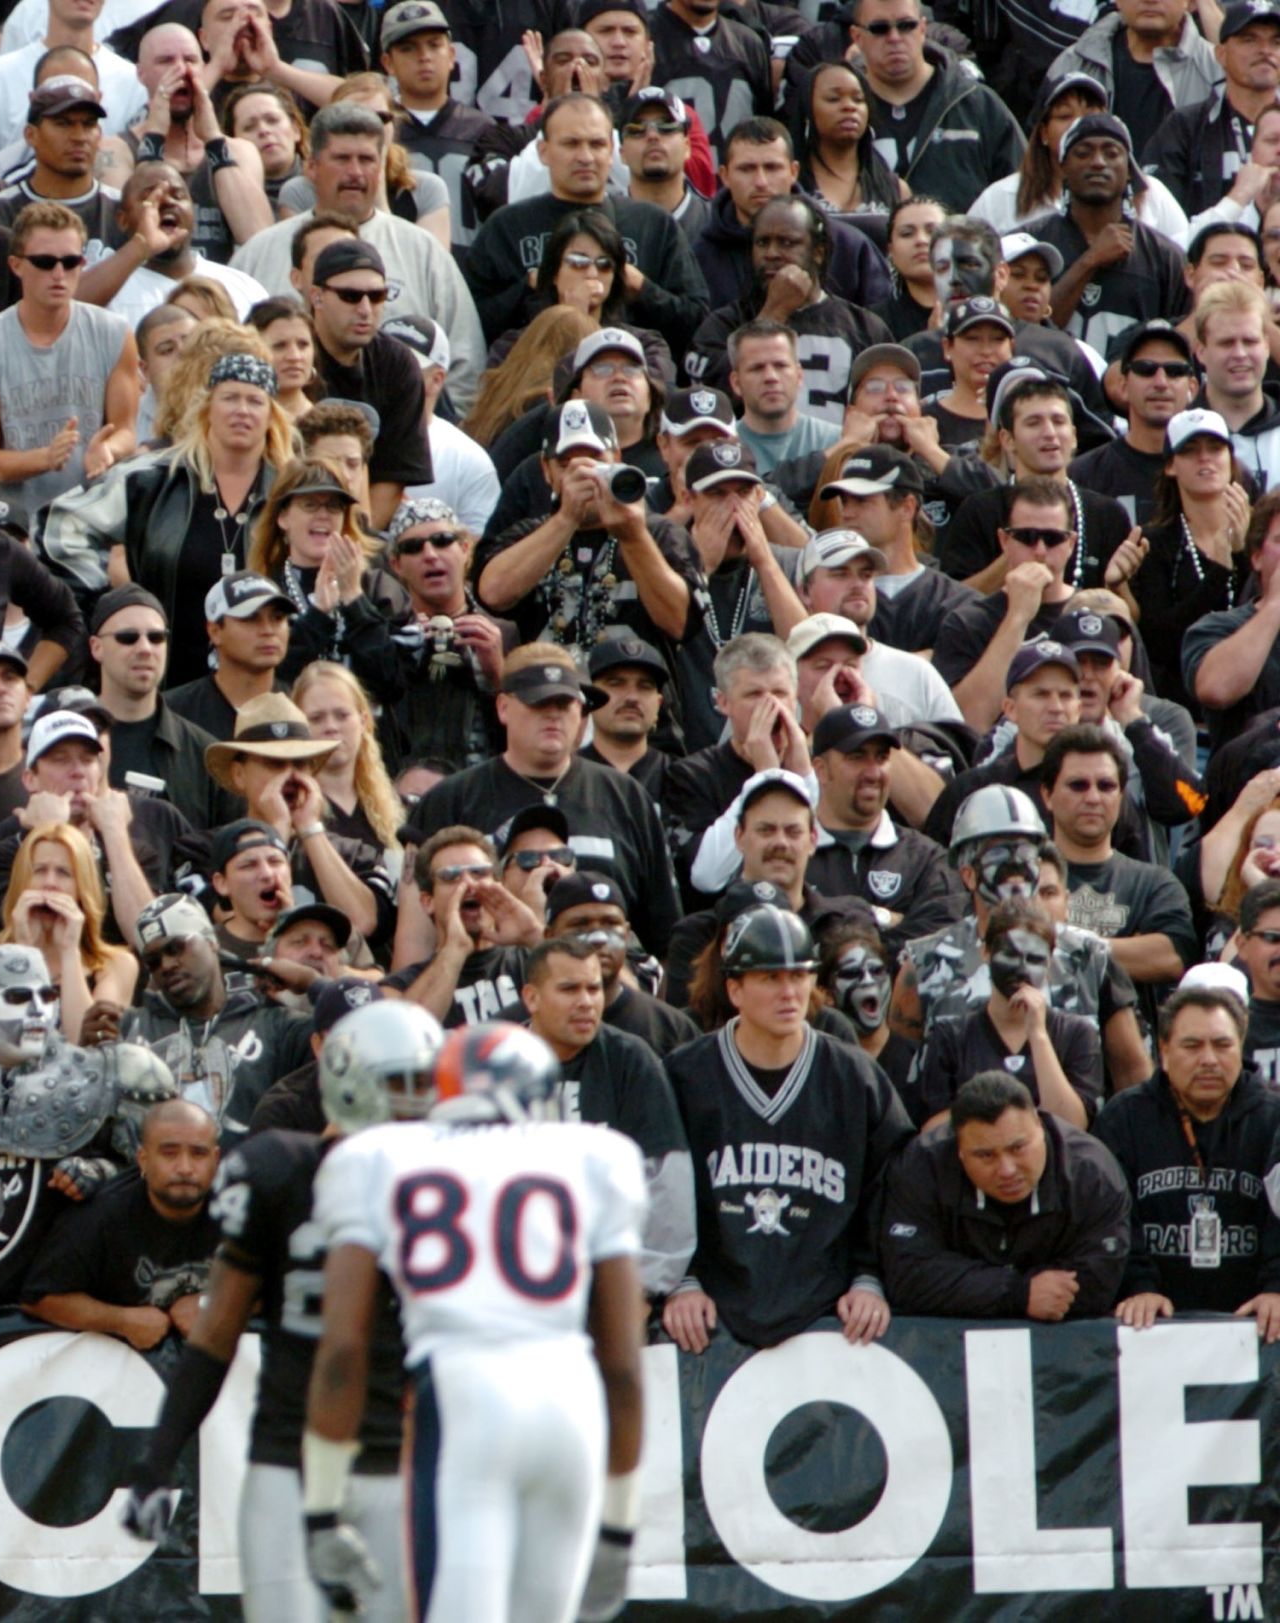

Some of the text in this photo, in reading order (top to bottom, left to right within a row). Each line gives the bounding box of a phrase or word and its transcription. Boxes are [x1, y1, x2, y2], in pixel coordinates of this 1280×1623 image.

[390, 1166, 579, 1305] 80
[1143, 1223, 1259, 1257] RAIRS
[629, 1321, 1264, 1602] OLE
[1205, 1584, 1265, 1621] TM
